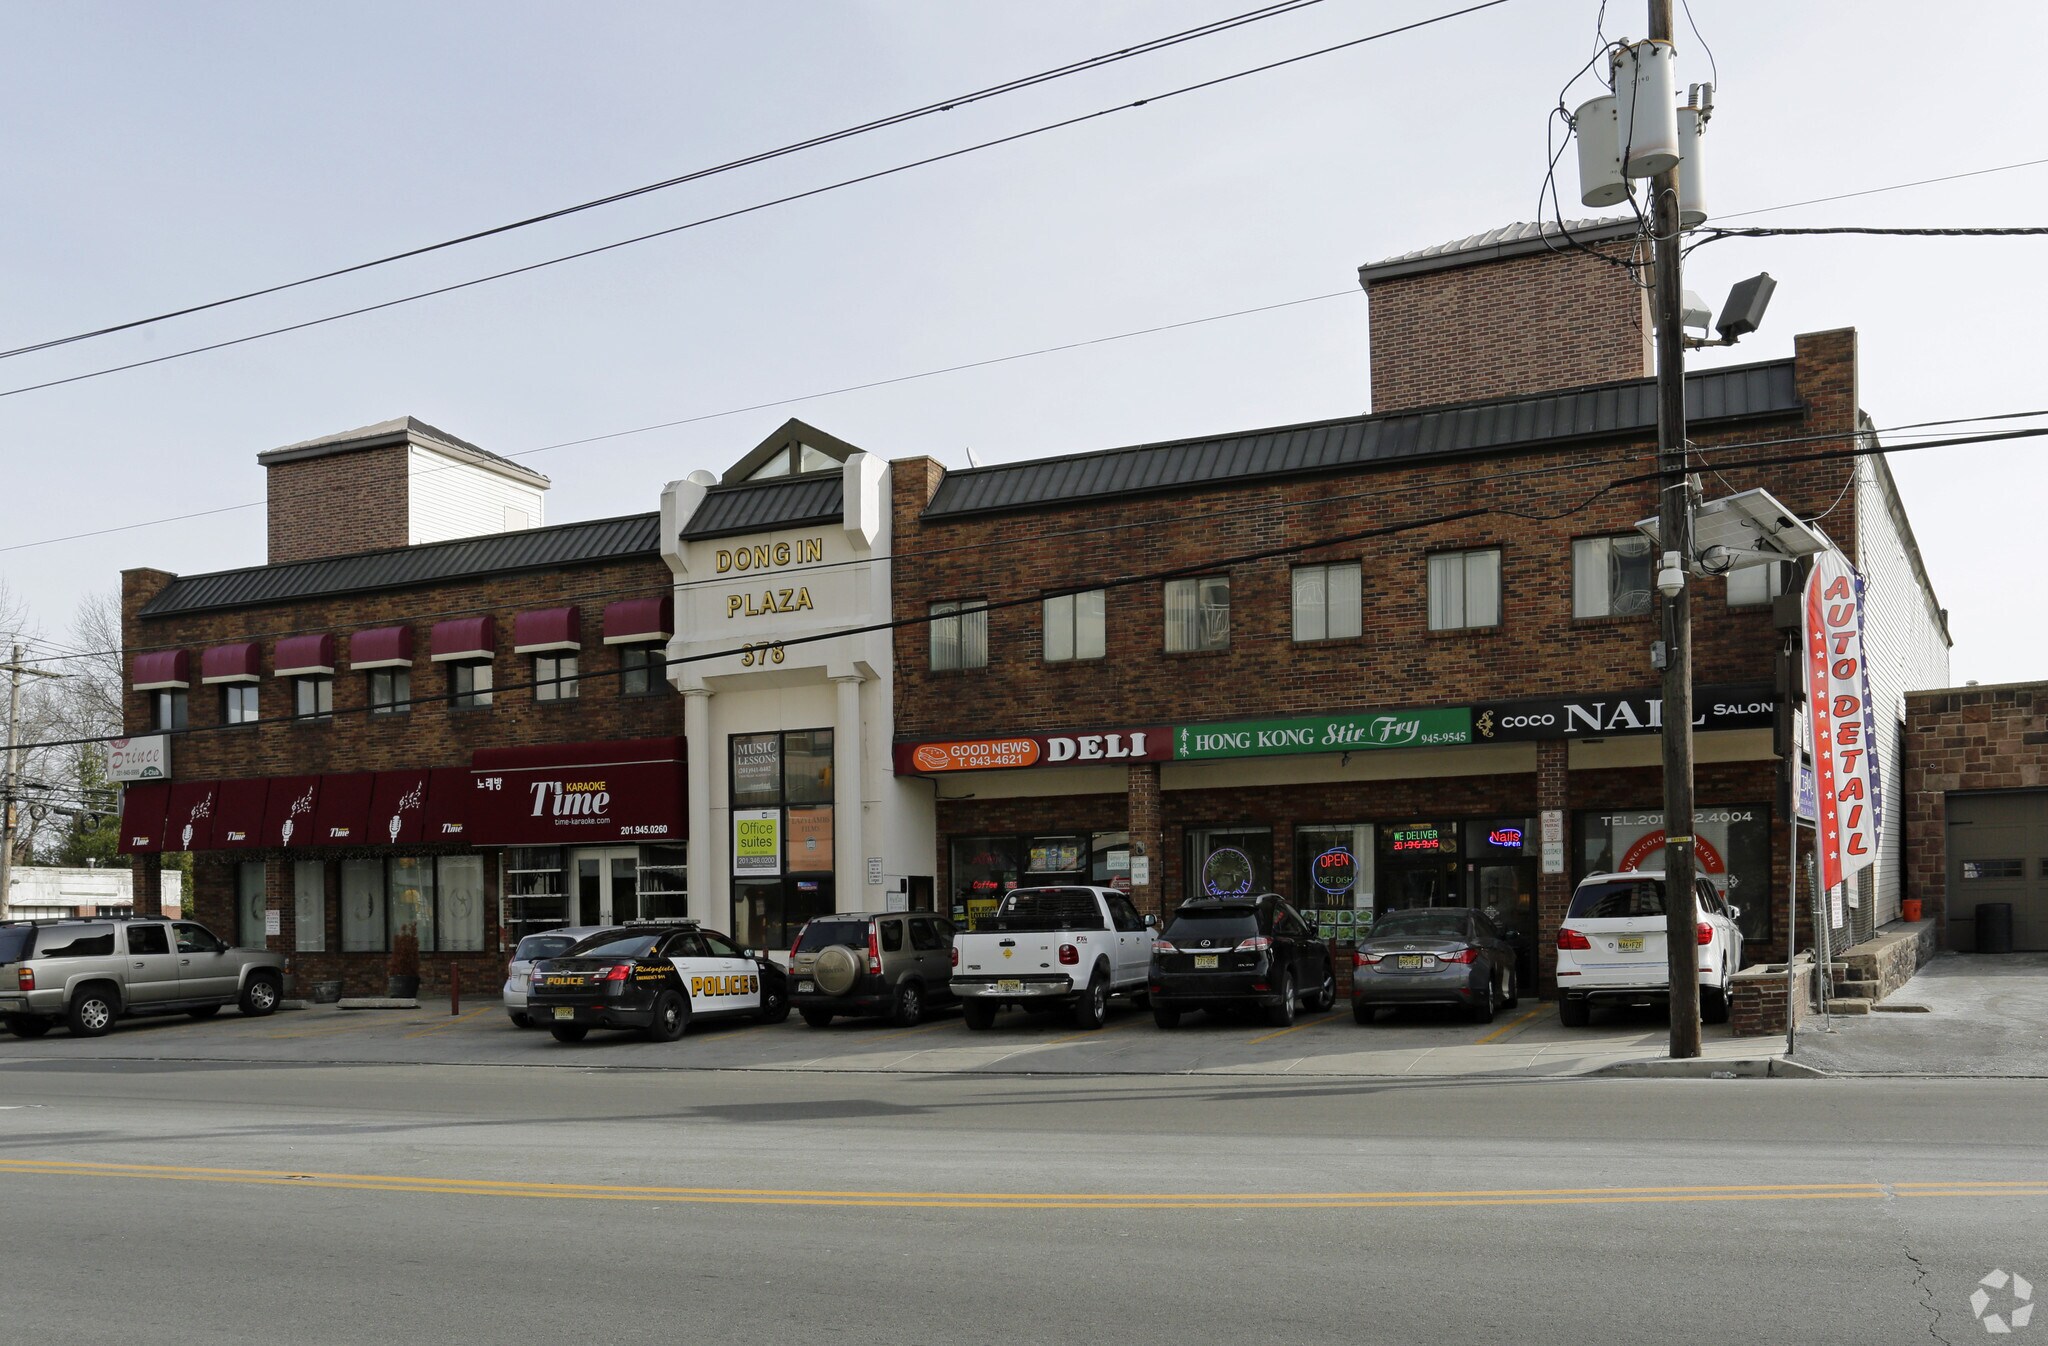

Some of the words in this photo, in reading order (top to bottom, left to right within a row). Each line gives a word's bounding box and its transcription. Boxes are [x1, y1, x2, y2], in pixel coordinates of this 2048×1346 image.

[727, 587, 813, 618] PLAZA
[1824, 575, 1856, 681] AUTO
[741, 640, 785, 667] 378
[1713, 702, 1774, 716] SALON
[1195, 732, 1250, 751] HONG
[1257, 728, 1314, 748] KONG
[1322, 723, 1366, 746] Stir
[1370, 716, 1420, 745] Fry
[1421, 731, 1466, 744] 945-9545
[737, 741, 776, 755] MUSIC
[951, 744, 991, 757] GOOD
[992, 741, 1030, 754] NEWS
[1047, 732, 1148, 761] DELI
[111, 747, 160, 770] Prince
[737, 753, 776, 765] LESSONS
[958, 757, 969, 767] T.
[970, 754, 1023, 766] 943-4621
[1833, 695, 1868, 856] DETAIL
[477, 777, 503, 791] 노래방
[566, 781, 606, 792] KARAOKE
[530, 781, 610, 817] Time
[555, 817, 611, 826] time-karaoke.com
[740, 822, 773, 834] Office
[620, 824, 668, 835] 201.945.0260
[1393, 831, 1405, 840] WE
[1406, 830, 1438, 840] DELIVER
[741, 835, 773, 848] suites
[1491, 831, 1520, 842] Nails
[1641, 835, 1665, 850] COLO
[1320, 854, 1349, 867] OPEN
[972, 880, 998, 889] Coffee
[1318, 876, 1334, 884] DIET
[1335, 876, 1353, 884] DISH
[635, 965, 675, 973] Ridgefield
[546, 976, 585, 985] POLICE
[690, 975, 750, 997] POLICE
